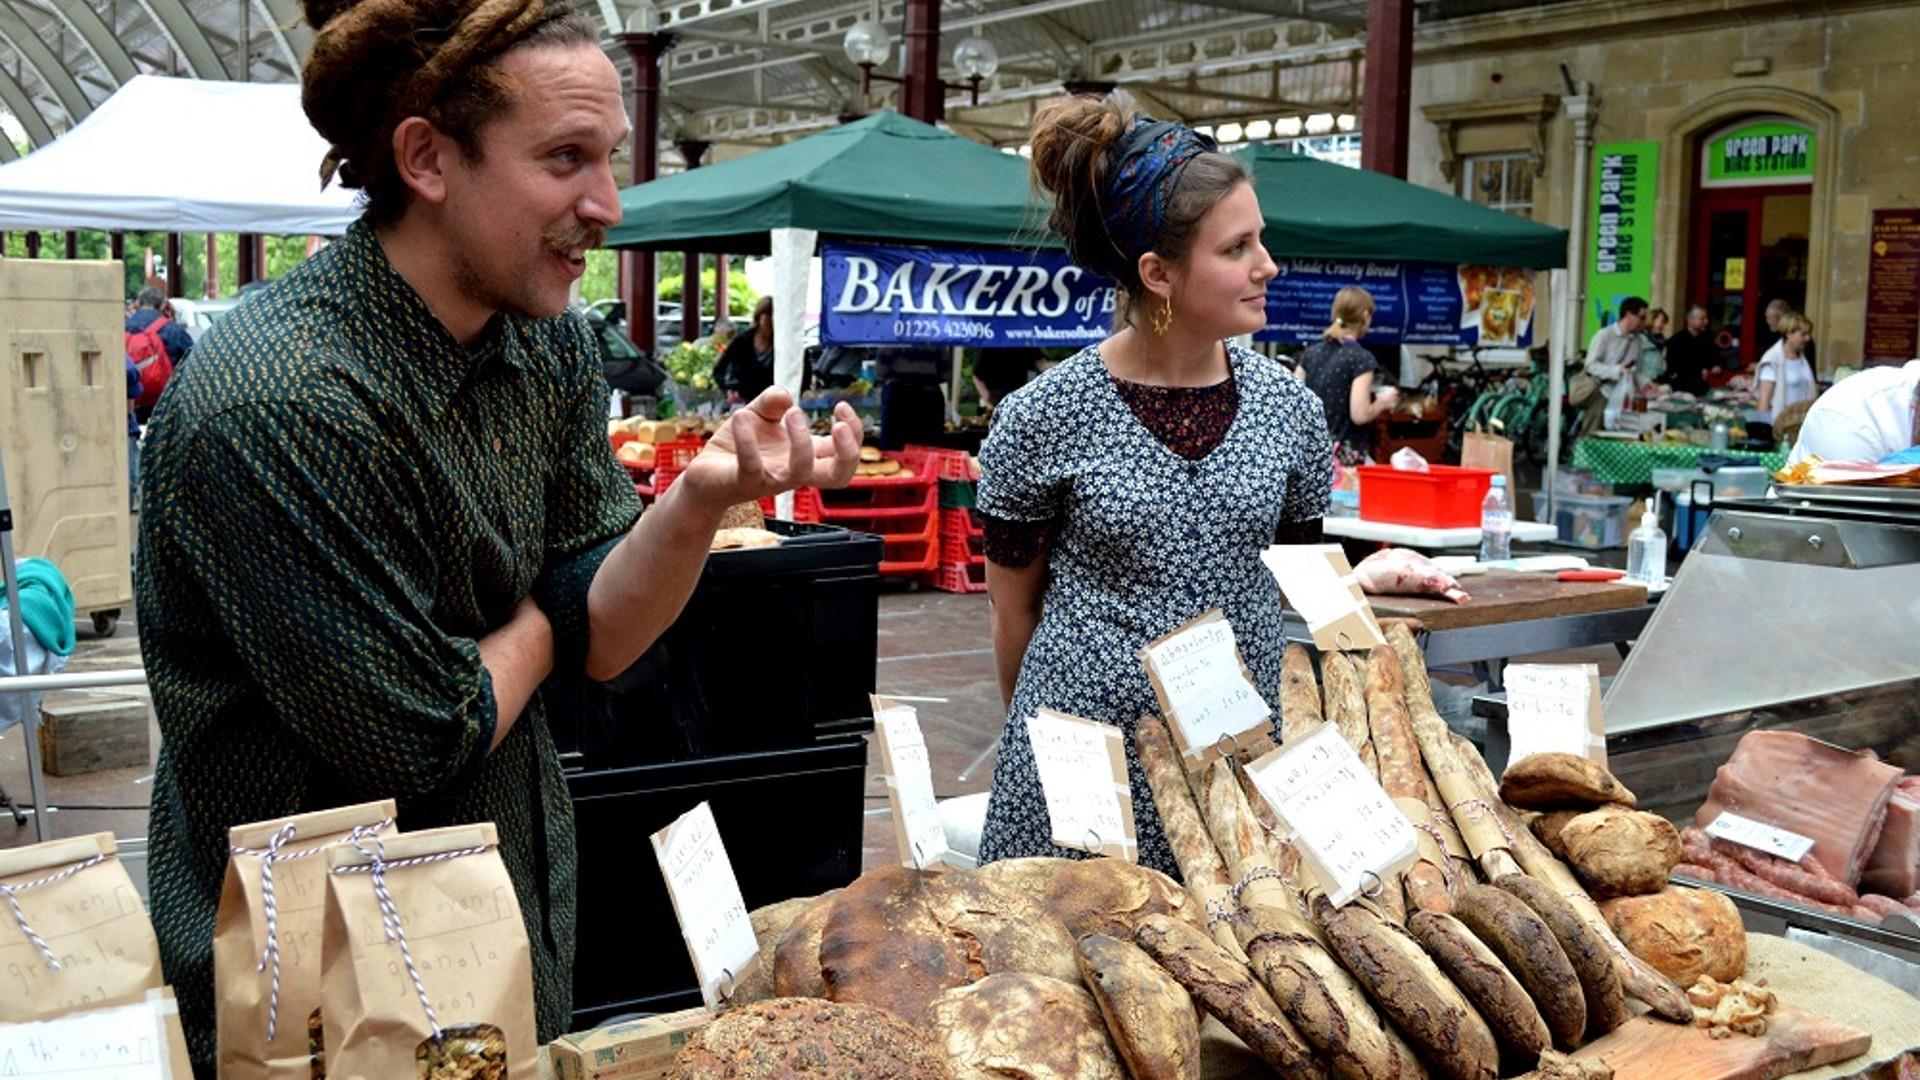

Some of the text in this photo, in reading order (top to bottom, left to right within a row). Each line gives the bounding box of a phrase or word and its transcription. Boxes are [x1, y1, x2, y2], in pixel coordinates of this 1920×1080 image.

[832, 256, 1083, 318] BAKERS
[1074, 286, 1103, 322] of
[1291, 259, 1323, 274] Made
[1325, 260, 1364, 280] Crusty
[1365, 262, 1400, 278] Bread
[894, 319, 1108, 340] 01225 423096 www.bakersofbath
[7, 939, 125, 997] grnola
[387, 940, 498, 997] ganola
